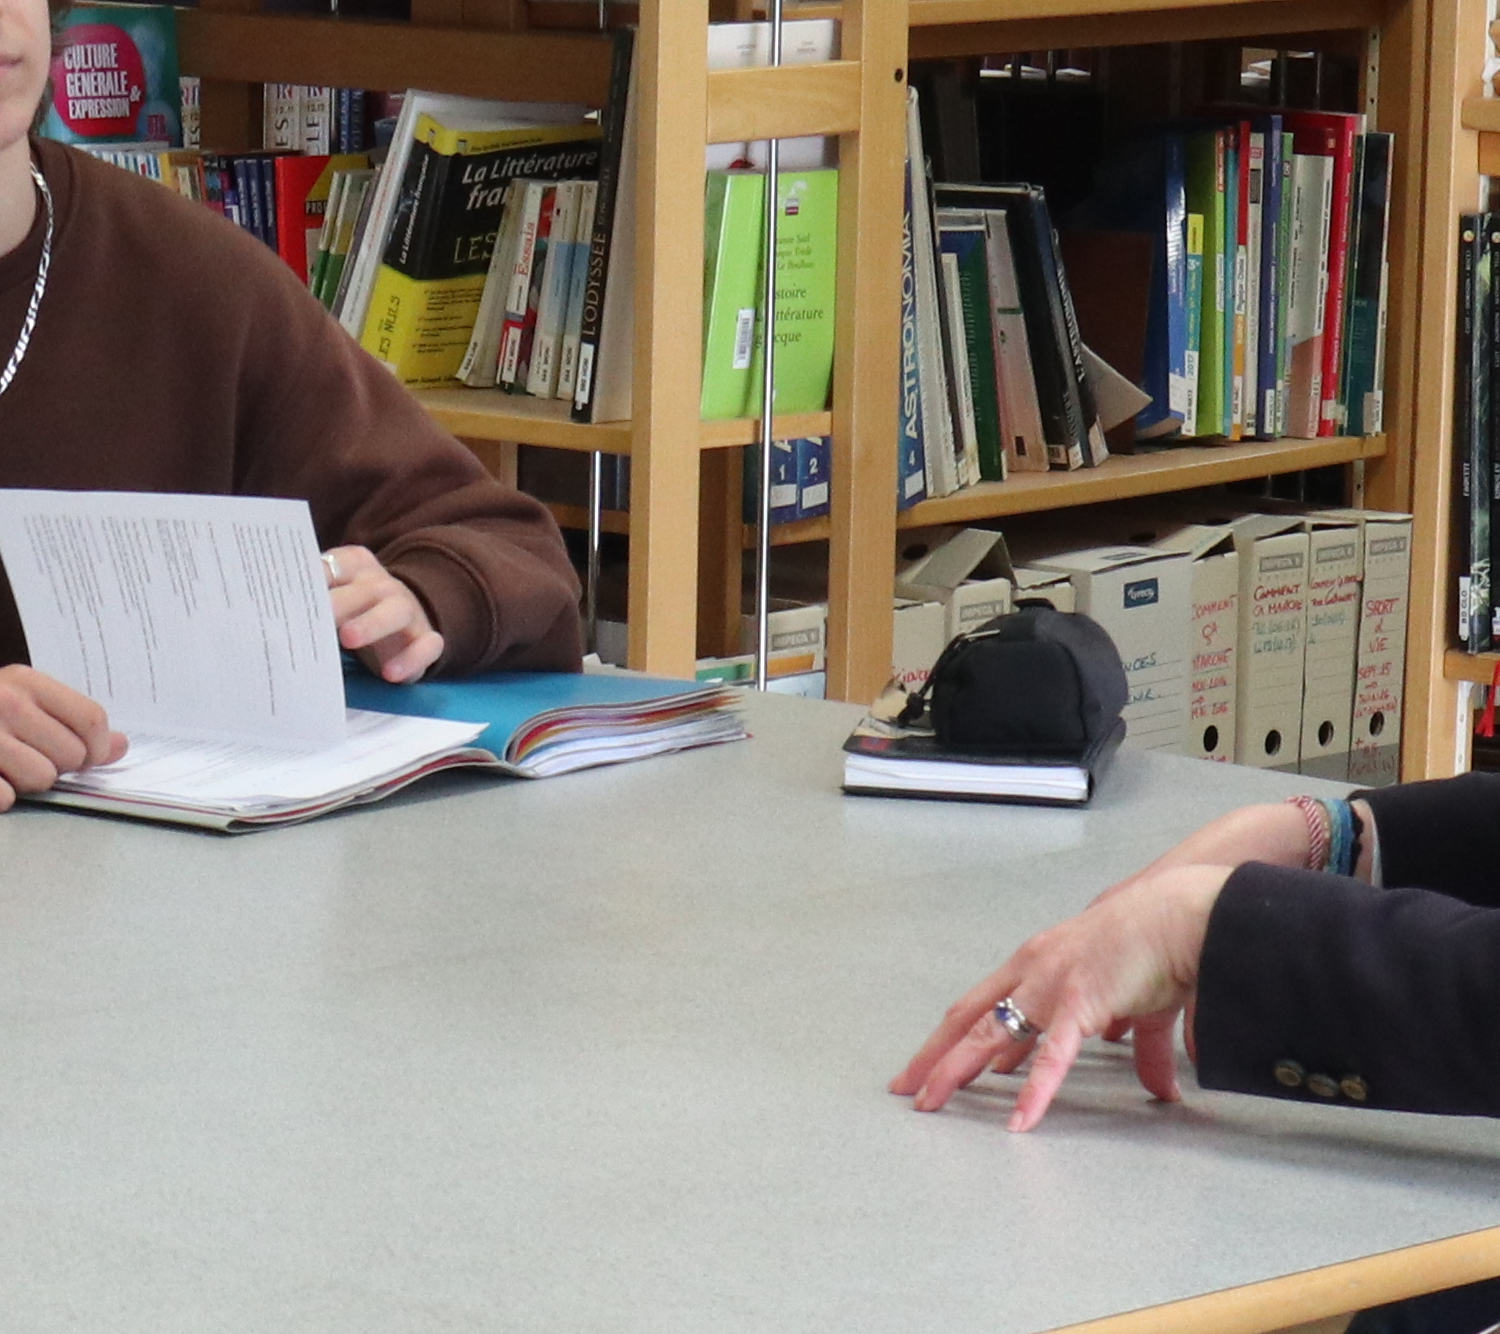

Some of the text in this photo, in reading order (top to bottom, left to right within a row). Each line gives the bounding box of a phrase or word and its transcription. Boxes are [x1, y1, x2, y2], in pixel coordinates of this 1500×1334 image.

[64, 42, 118, 70] CULTURE
[66, 67, 141, 103] GÉNÉRALE &
[68, 97, 131, 121] EXPRESSION
[461, 148, 599, 185] La Littérature
[517, 221, 536, 277] Essais
[386, 295, 401, 334] NULS
[901, 211, 920, 440] ASTRONOMIA
[808, 456, 819, 475] 2
[908, 452, 917, 466] 4
[778, 464, 786, 482] 1
[1253, 583, 1302, 603] COMMENT
[1365, 598, 1400, 618] SPORT
[1369, 636, 1389, 654] VIE
